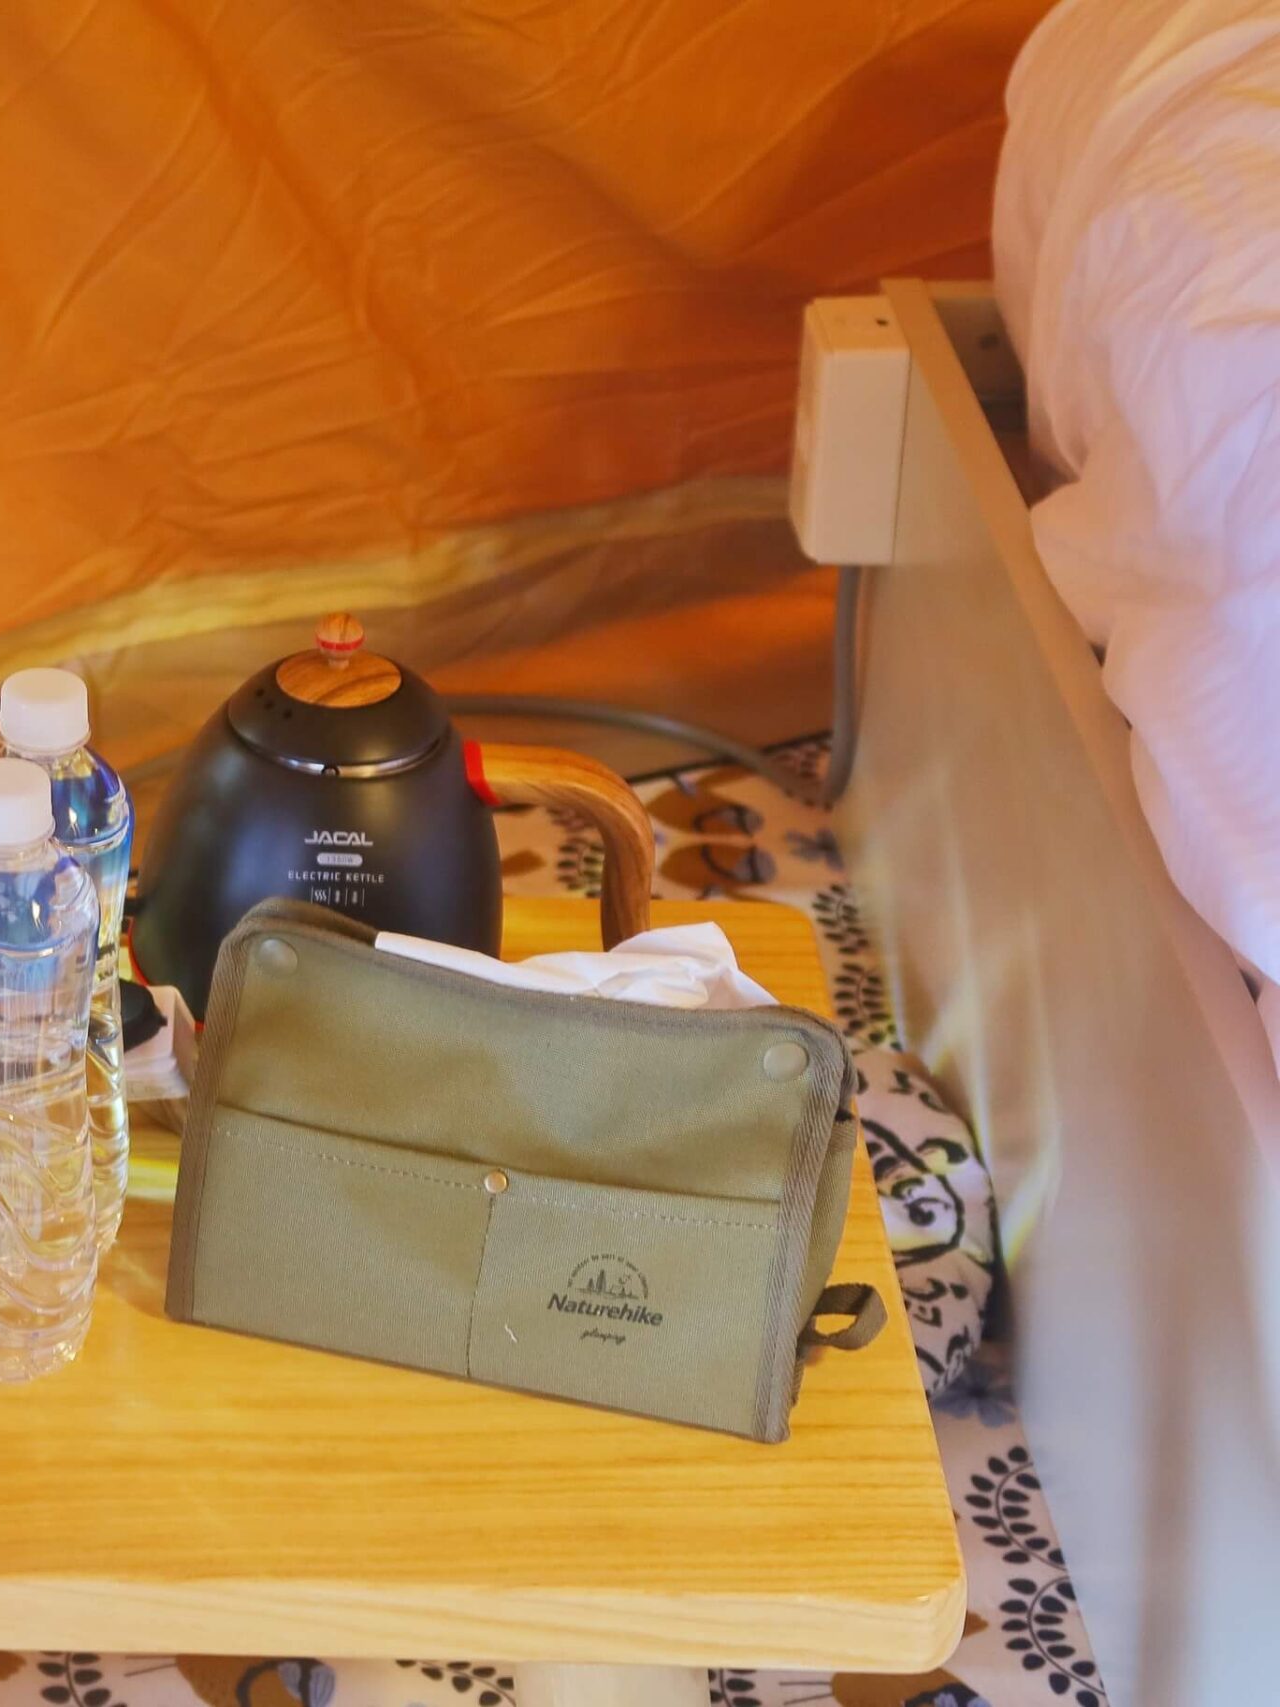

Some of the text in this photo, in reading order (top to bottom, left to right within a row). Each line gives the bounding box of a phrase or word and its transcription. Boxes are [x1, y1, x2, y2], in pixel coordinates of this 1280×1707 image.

[304, 830, 374, 847] JACAL
[288, 869, 385, 884] ELECTRIC KETTLE
[547, 1292, 664, 1327] Naturehike
